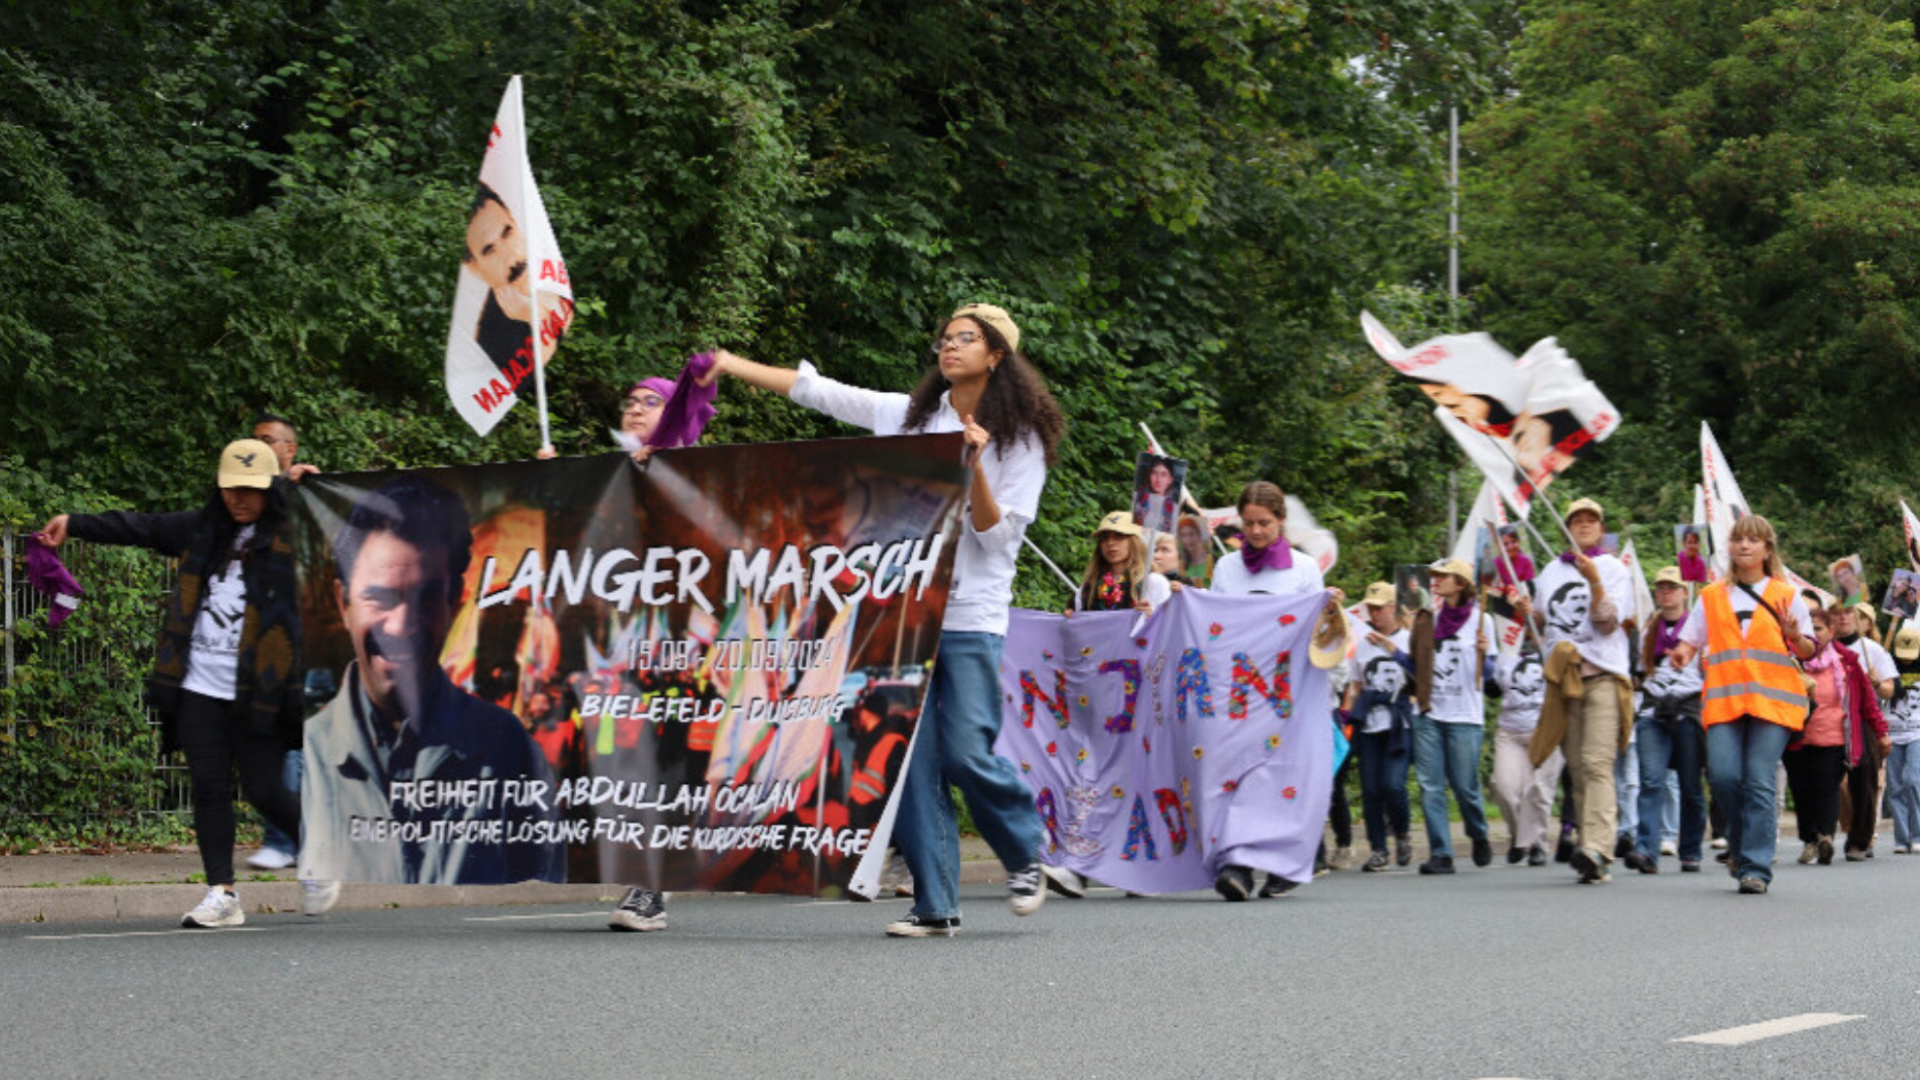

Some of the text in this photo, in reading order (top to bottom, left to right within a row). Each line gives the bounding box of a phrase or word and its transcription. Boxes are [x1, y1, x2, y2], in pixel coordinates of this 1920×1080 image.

[477, 533, 943, 615] LANGER MARSCH
[628, 639, 688, 671] 15.09
[713, 638, 836, 671] 20.09.2024
[580, 694, 727, 723] BIELEFELD
[389, 777, 498, 812] FREIHEIT
[502, 773, 549, 812] FÜR
[553, 775, 712, 815] ABDULLAH
[390, 817, 503, 845] POLITISCHE
[506, 815, 590, 845] LÖSUNG
[593, 814, 643, 850] FÜR
[649, 824, 690, 850] DIE
[692, 823, 787, 854] KURDISCHE
[789, 827, 870, 857] FRAGE
